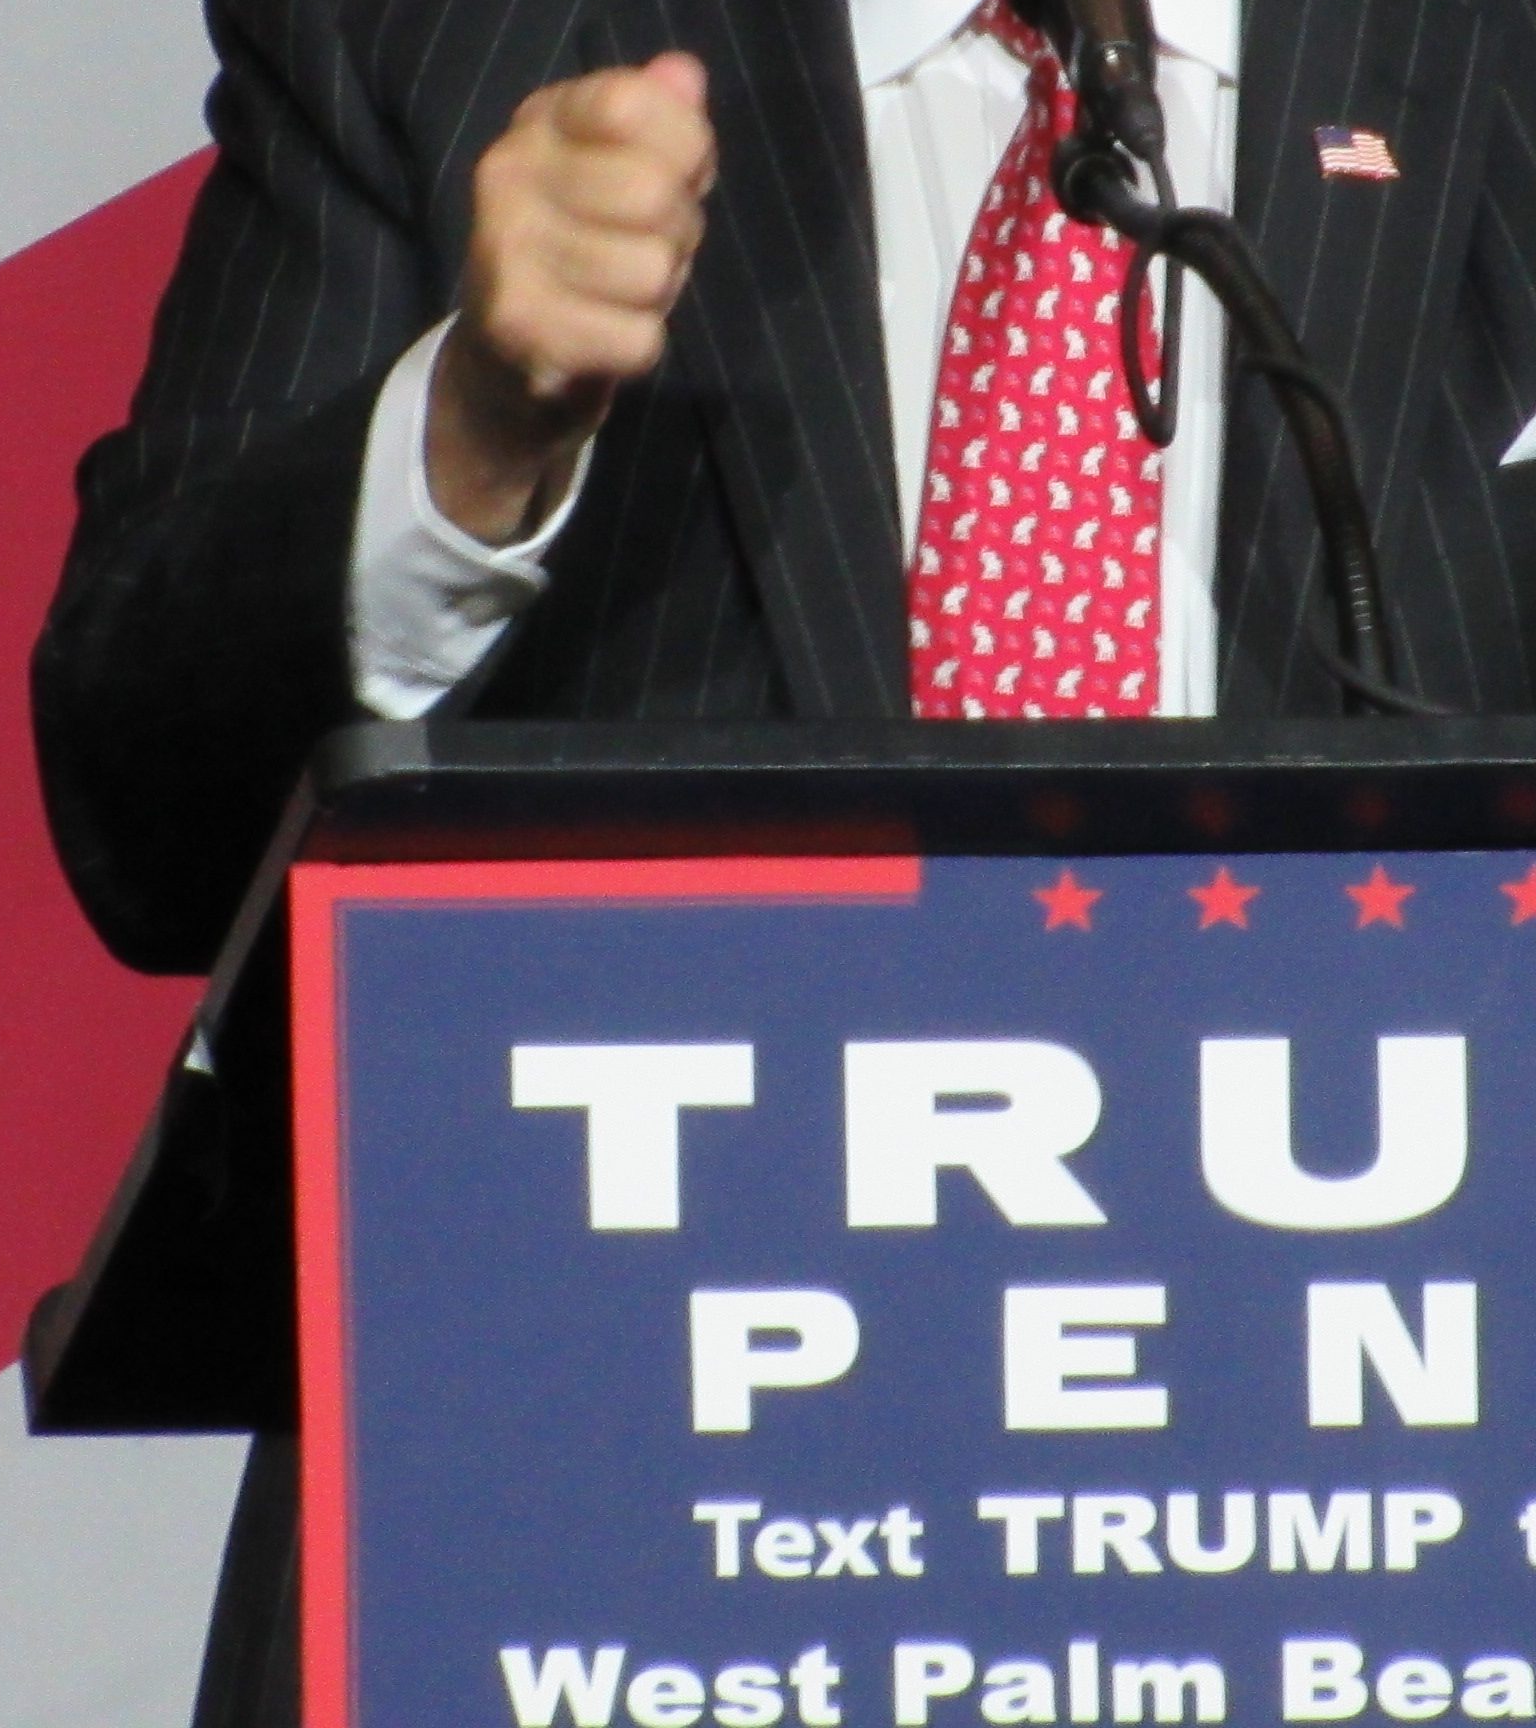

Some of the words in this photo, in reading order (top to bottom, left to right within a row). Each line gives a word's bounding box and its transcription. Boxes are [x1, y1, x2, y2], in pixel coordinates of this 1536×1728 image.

[691, 1499, 925, 1578] Text
[976, 1489, 1464, 1576] TRUMP
[498, 1643, 842, 1728] West
[892, 1639, 1227, 1727] Palm
